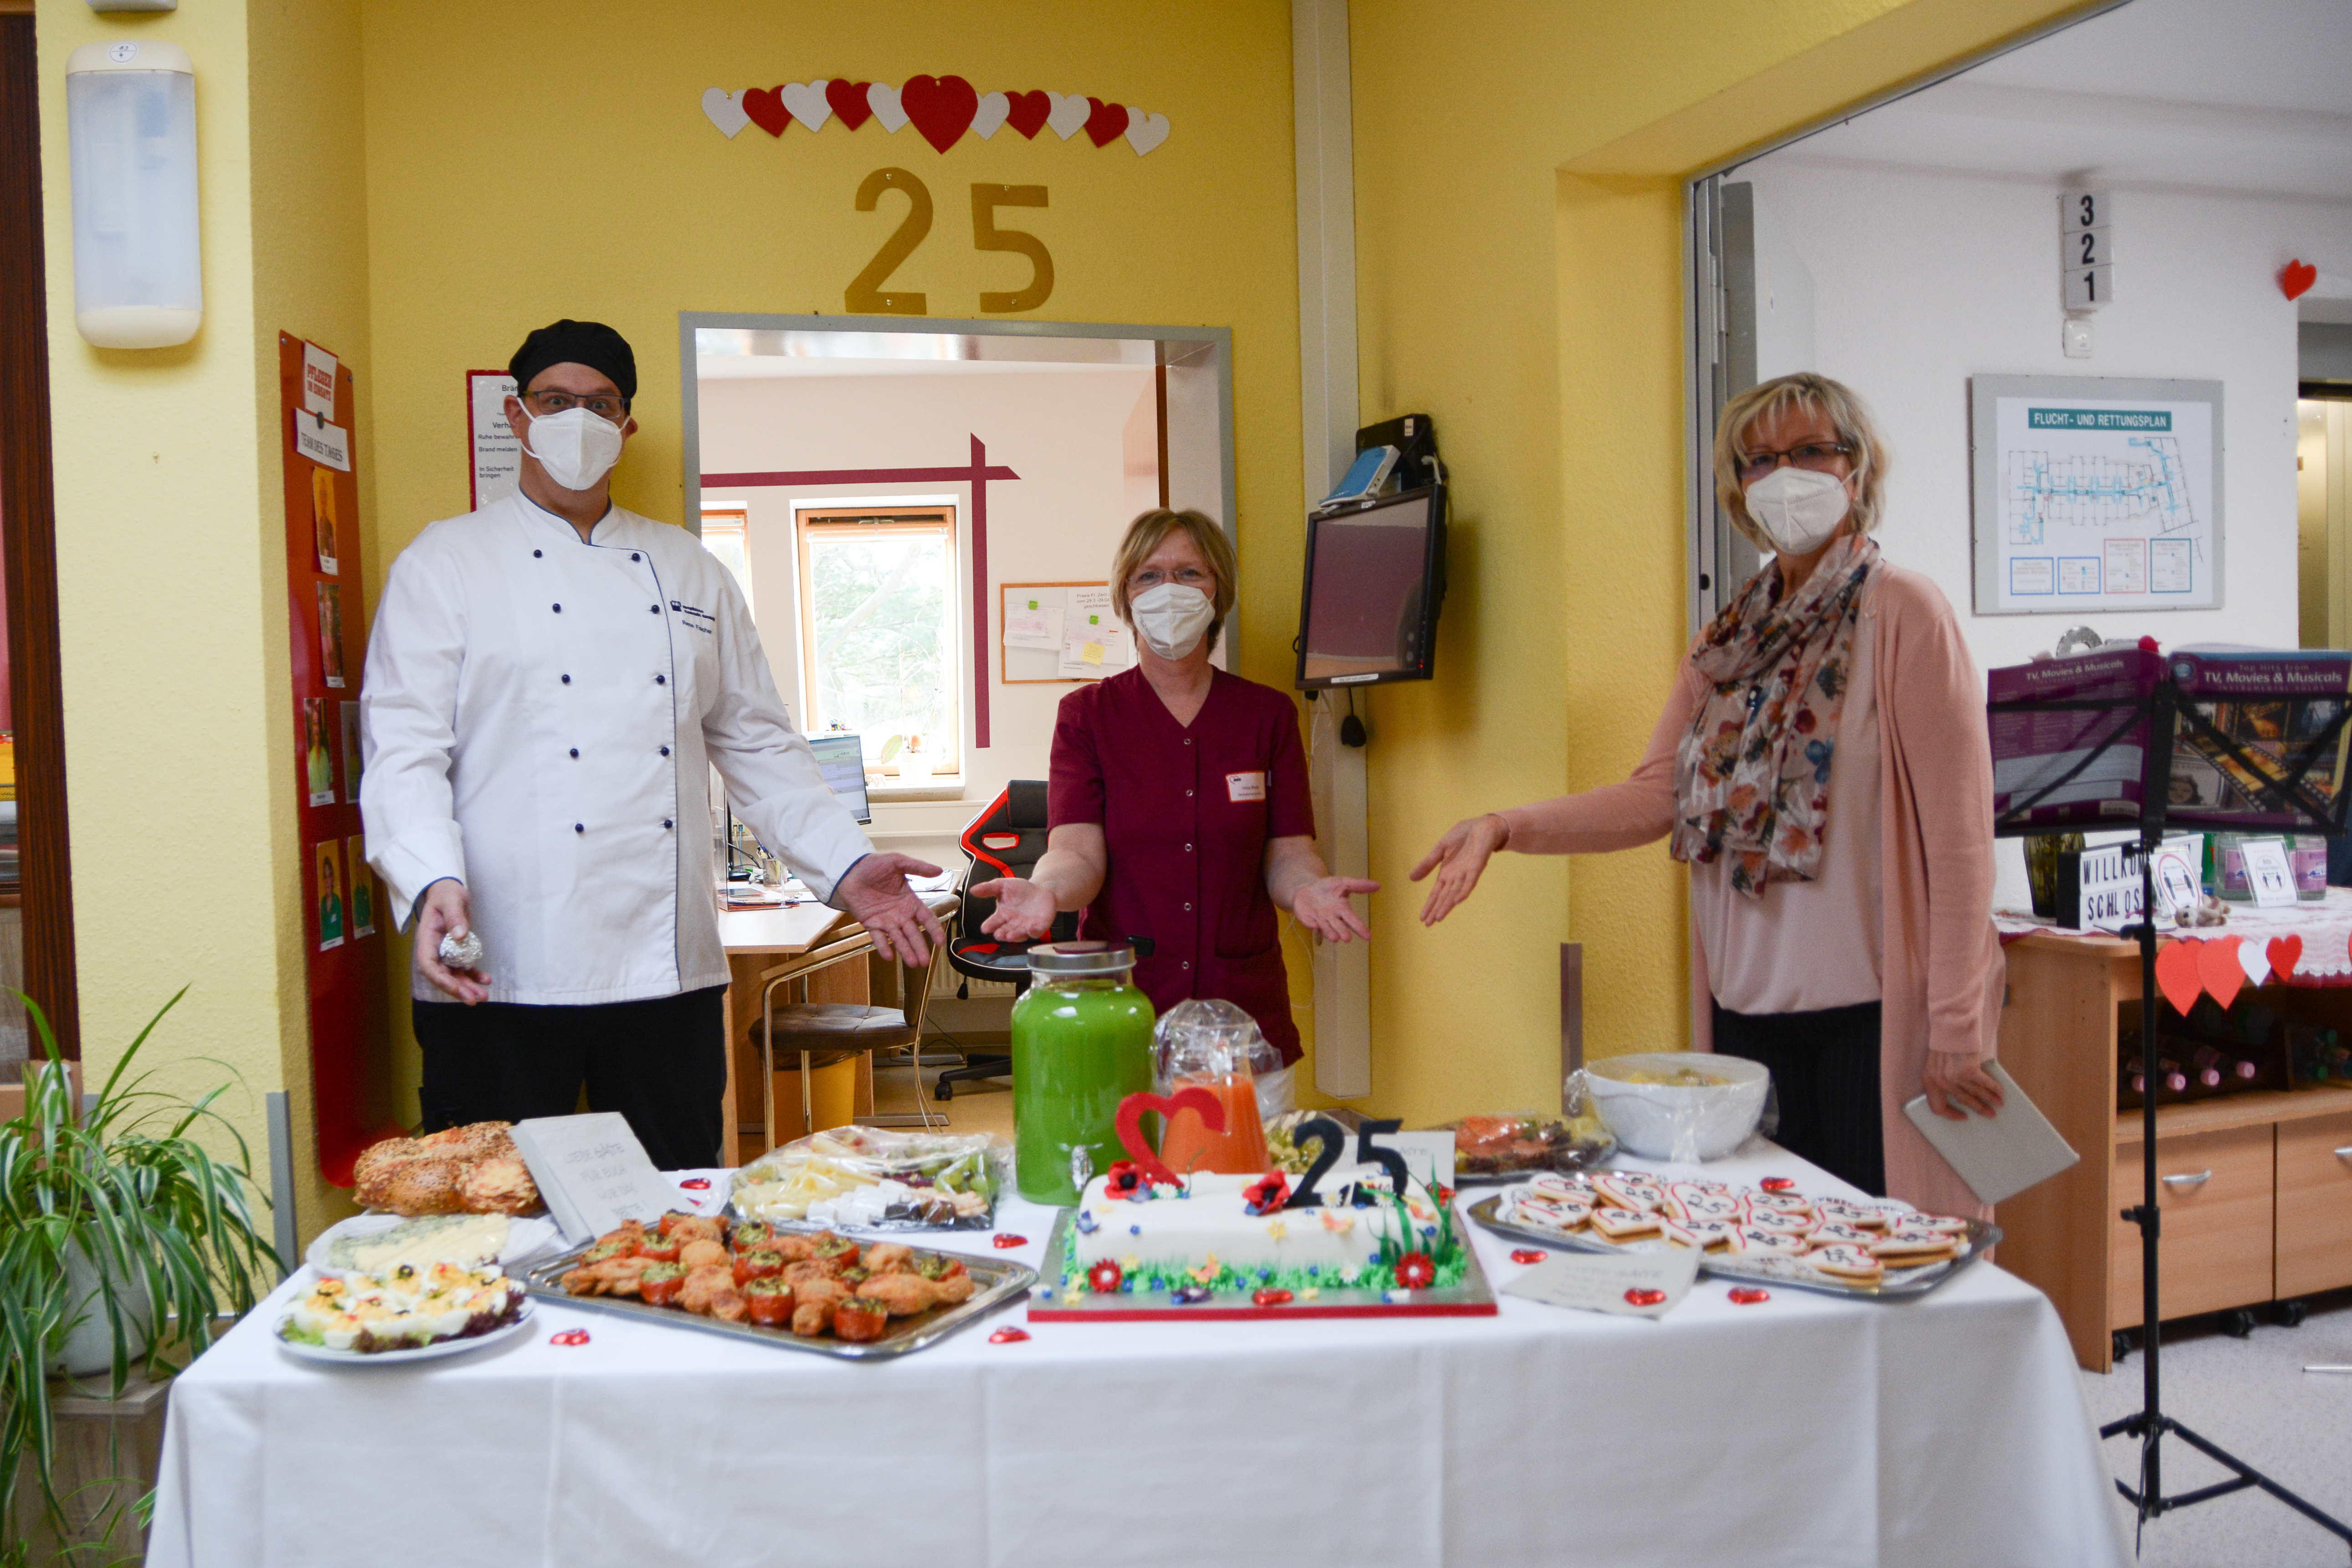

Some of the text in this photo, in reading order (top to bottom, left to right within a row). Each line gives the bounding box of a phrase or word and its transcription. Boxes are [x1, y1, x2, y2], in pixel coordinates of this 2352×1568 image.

[2080, 195, 2094, 226] 3
[844, 166, 1055, 315] 25
[2081, 233, 2095, 265] 2
[2084, 271, 2095, 302] 1
[307, 363, 332, 389] PFLEGER
[313, 383, 332, 401] EINSATZ
[2034, 412, 2167, 427] FLUCHT- UND RETTUNGSPLAN
[301, 432, 343, 462] TEAM DES TAGES
[2027, 672, 2039, 680] TV,
[2042, 668, 2074, 678] Movies
[2085, 659, 2124, 672] Musicals
[2204, 672, 2342, 683] TV, Movies & Musicals
[2084, 853, 2145, 884] WILLKOM
[2088, 888, 2140, 921] SCHLOS
[1284, 1117, 1409, 1208] 25
[1687, 1193, 1729, 1213] 25
